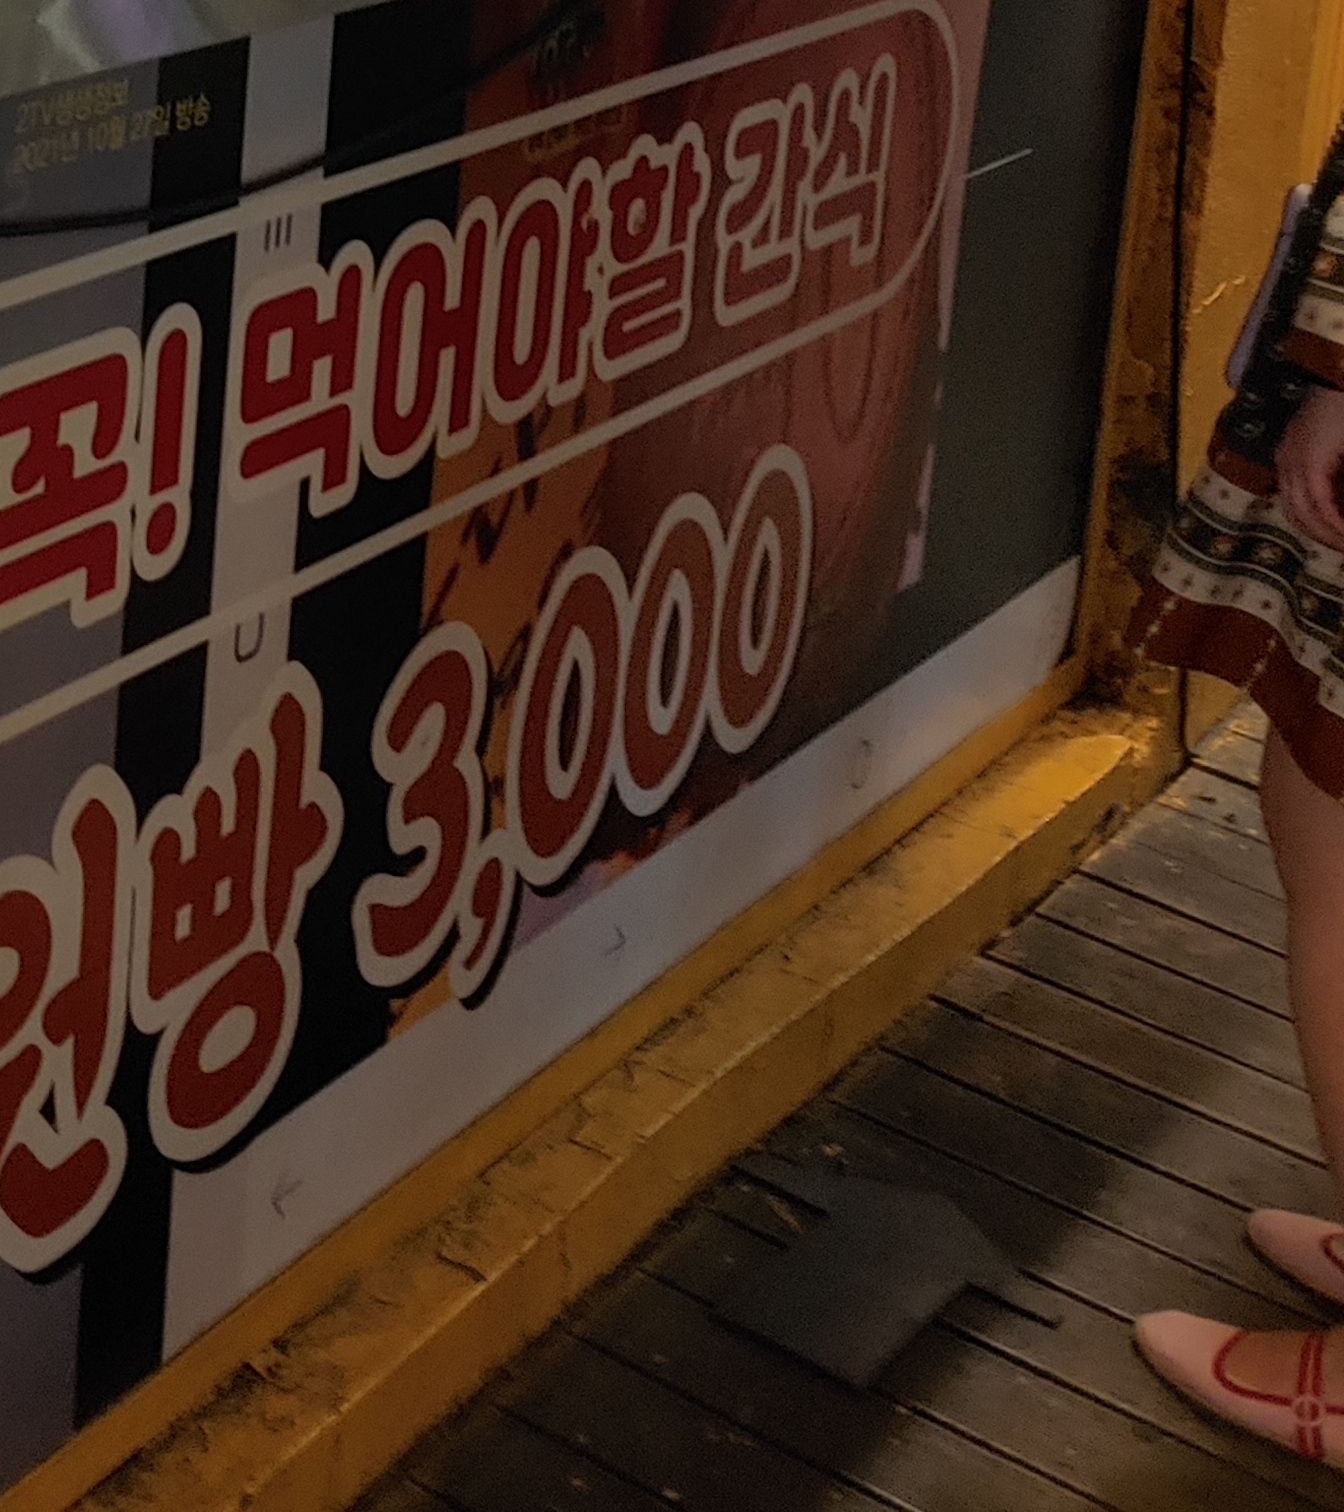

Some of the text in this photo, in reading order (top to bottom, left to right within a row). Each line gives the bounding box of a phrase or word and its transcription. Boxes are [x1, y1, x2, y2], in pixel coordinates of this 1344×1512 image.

[175, 92, 212, 132] 방송
[232, 128, 710, 500] 먹어야할
[714, 56, 898, 324] 간식
[354, 446, 812, 1012] 3,000
